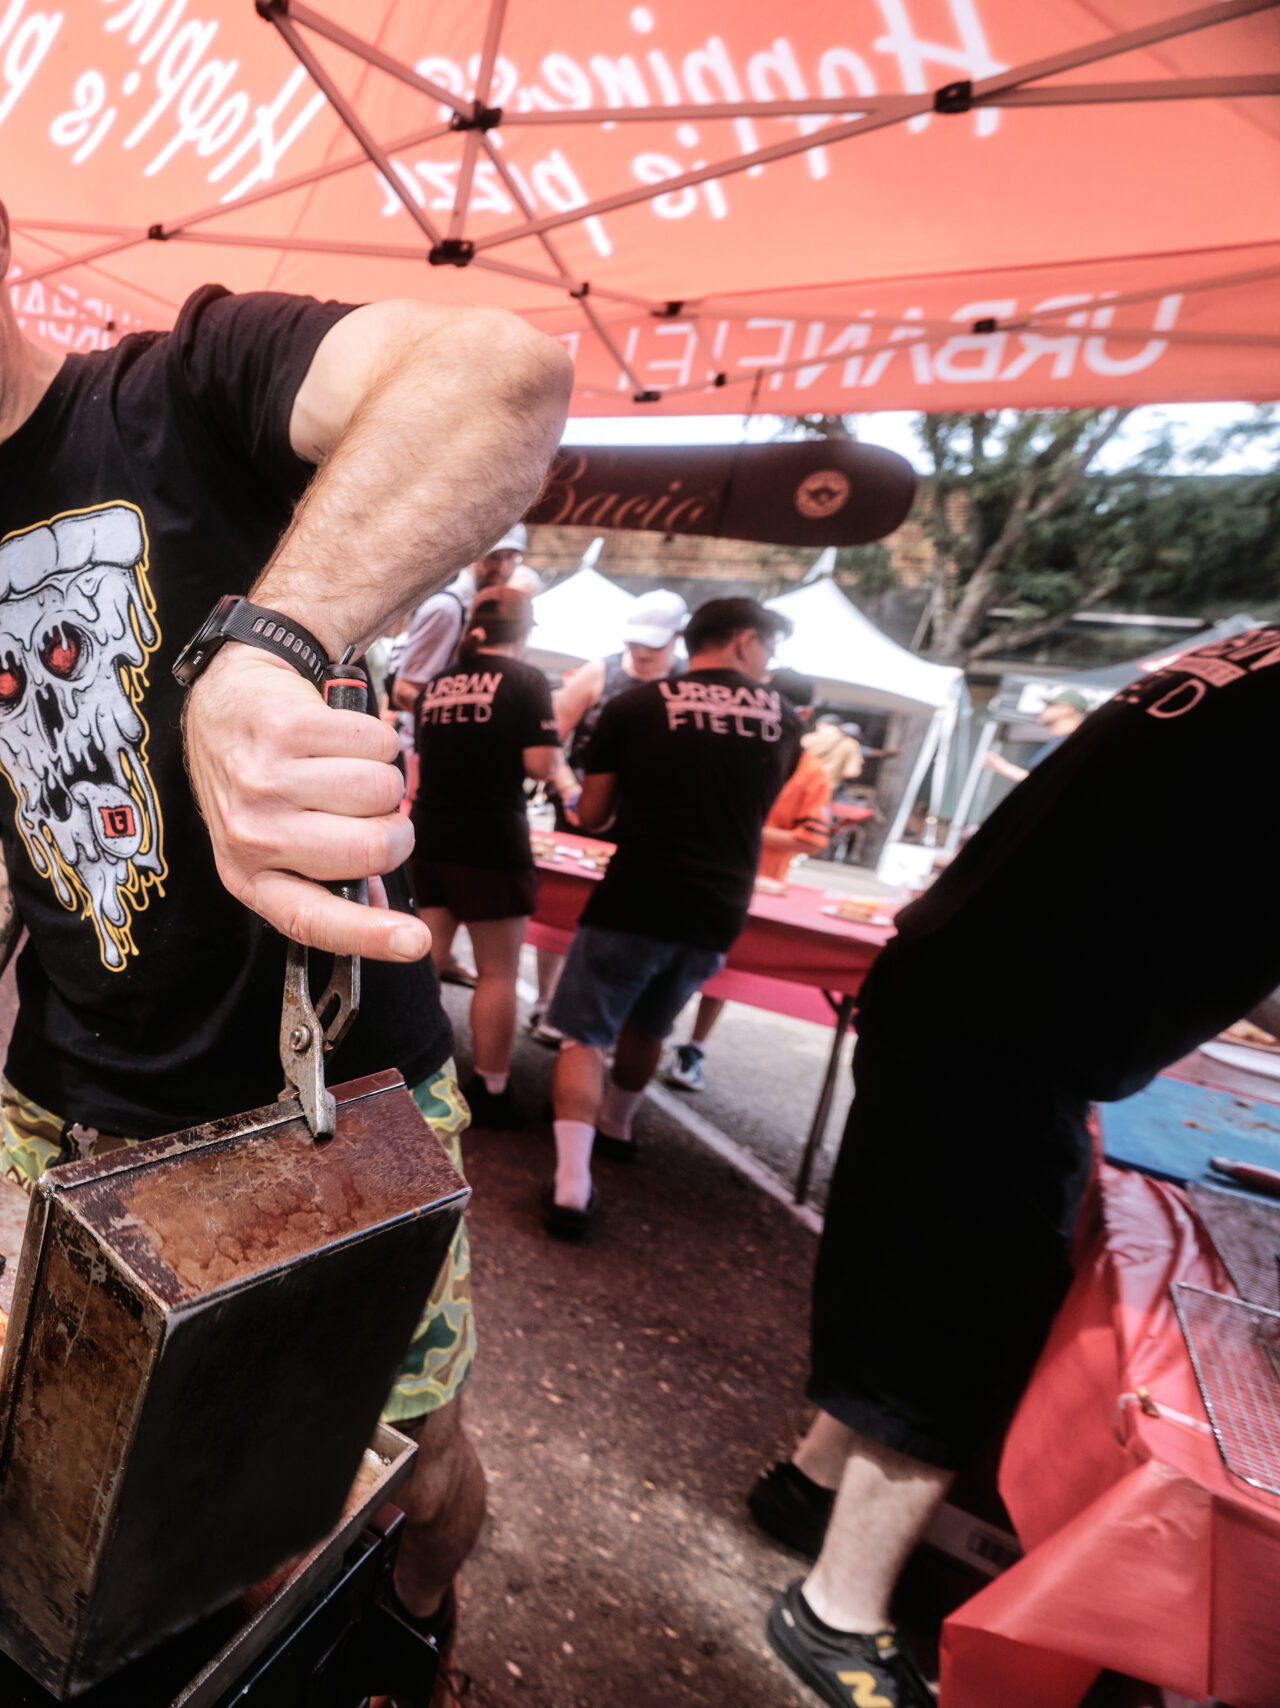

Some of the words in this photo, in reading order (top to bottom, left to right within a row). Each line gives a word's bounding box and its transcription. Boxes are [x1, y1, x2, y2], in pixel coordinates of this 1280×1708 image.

[424, 671, 503, 700] URBAN
[658, 680, 781, 717] URBAN
[421, 702, 493, 725] FIELD
[668, 712, 783, 743] FIELD
